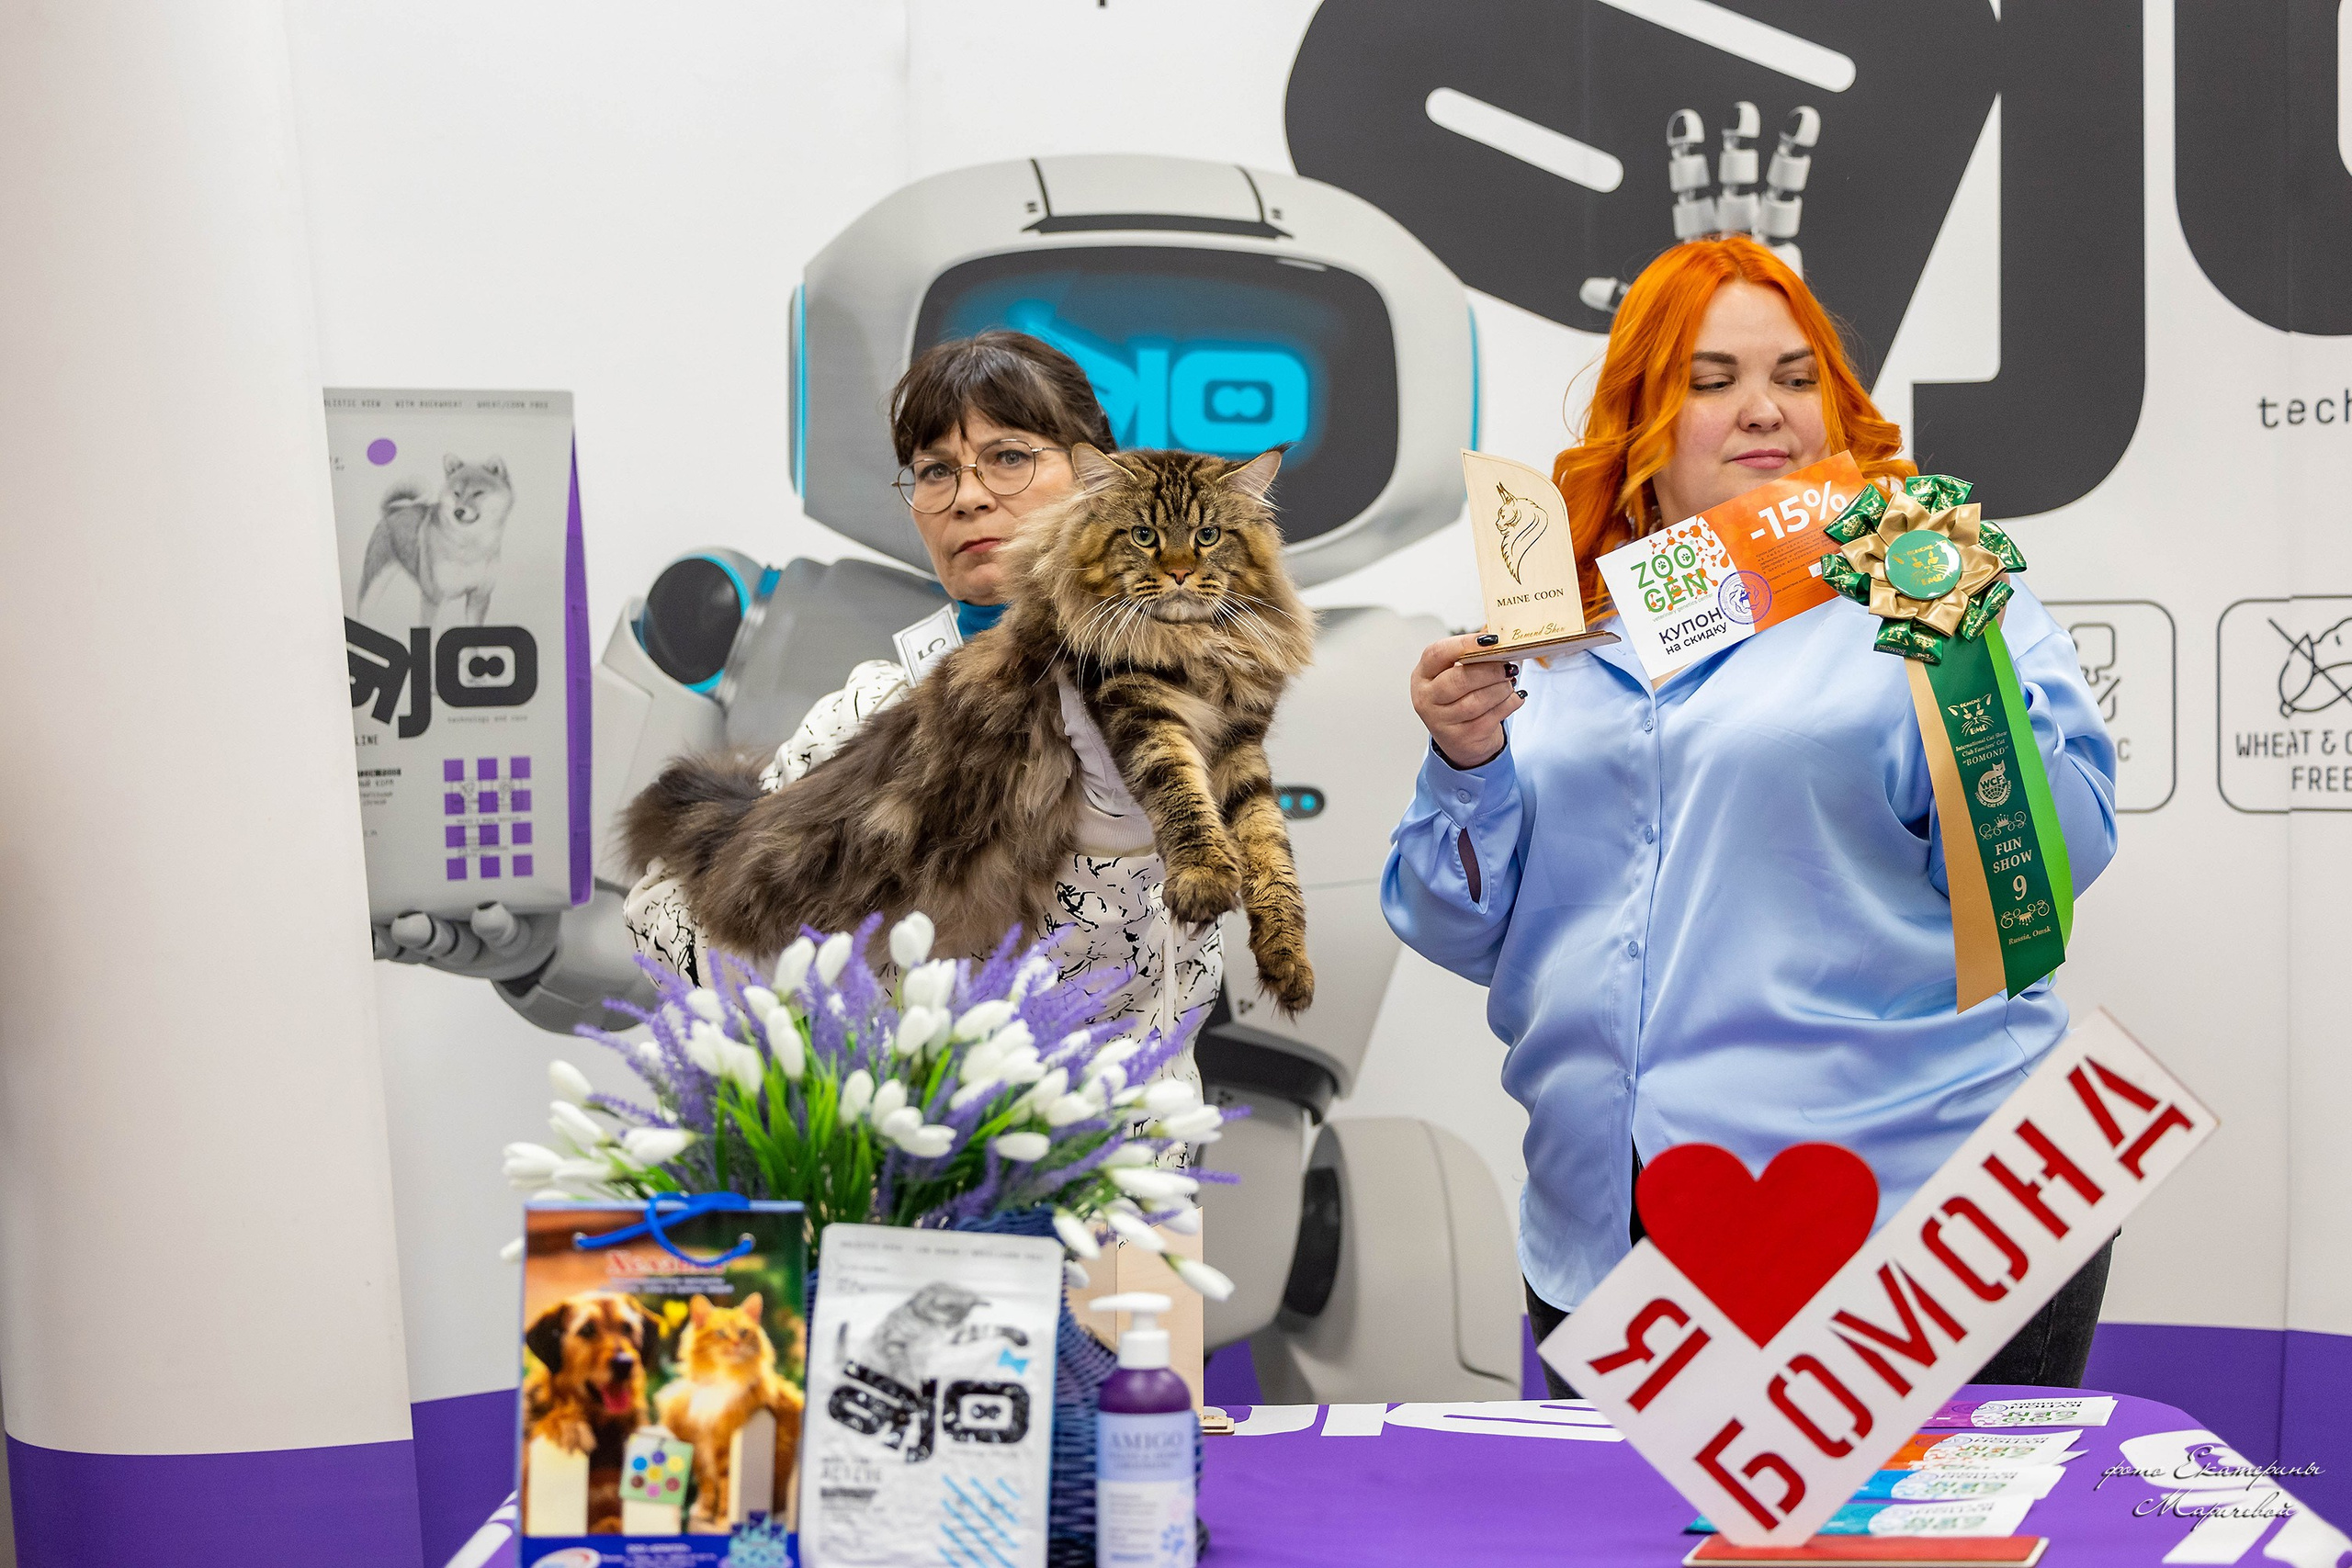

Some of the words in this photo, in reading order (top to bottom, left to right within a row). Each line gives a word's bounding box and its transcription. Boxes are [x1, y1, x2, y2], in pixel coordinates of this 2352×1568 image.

[1749, 479, 1849, 541] -15%
[1631, 544, 1696, 589] ZOO
[1496, 593, 1531, 608] MAINE
[1533, 588, 1565, 602] COON
[1644, 569, 1708, 613] GEN
[1652, 608, 1677, 623] veterinary
[1677, 600, 1698, 614] genetics
[1658, 607, 1723, 645] КУПОН
[1666, 643, 1682, 655] на
[1683, 622, 1727, 648] скидку
[1955, 736, 1986, 752] International
[1986, 735, 1995, 743] Cat
[1962, 748, 1974, 758] Club
[1996, 739, 2006, 747] Cat
[2235, 729, 2312, 758] WHEAT
[2321, 729, 2336, 755] &
[1979, 774, 2004, 790] WCF
[2291, 766, 2352, 791] FREE
[1995, 837, 2022, 856] FUN
[1993, 850, 2032, 874] SHOW
[2012, 874, 2028, 901] 9
[2007, 932, 2031, 945] Russia,
[2032, 925, 2052, 937] Omsk
[1693, 1055, 2196, 1534] БОМОНД
[1587, 1297, 1713, 1414] Я
[1109, 1430, 1184, 1450] AMIGO
